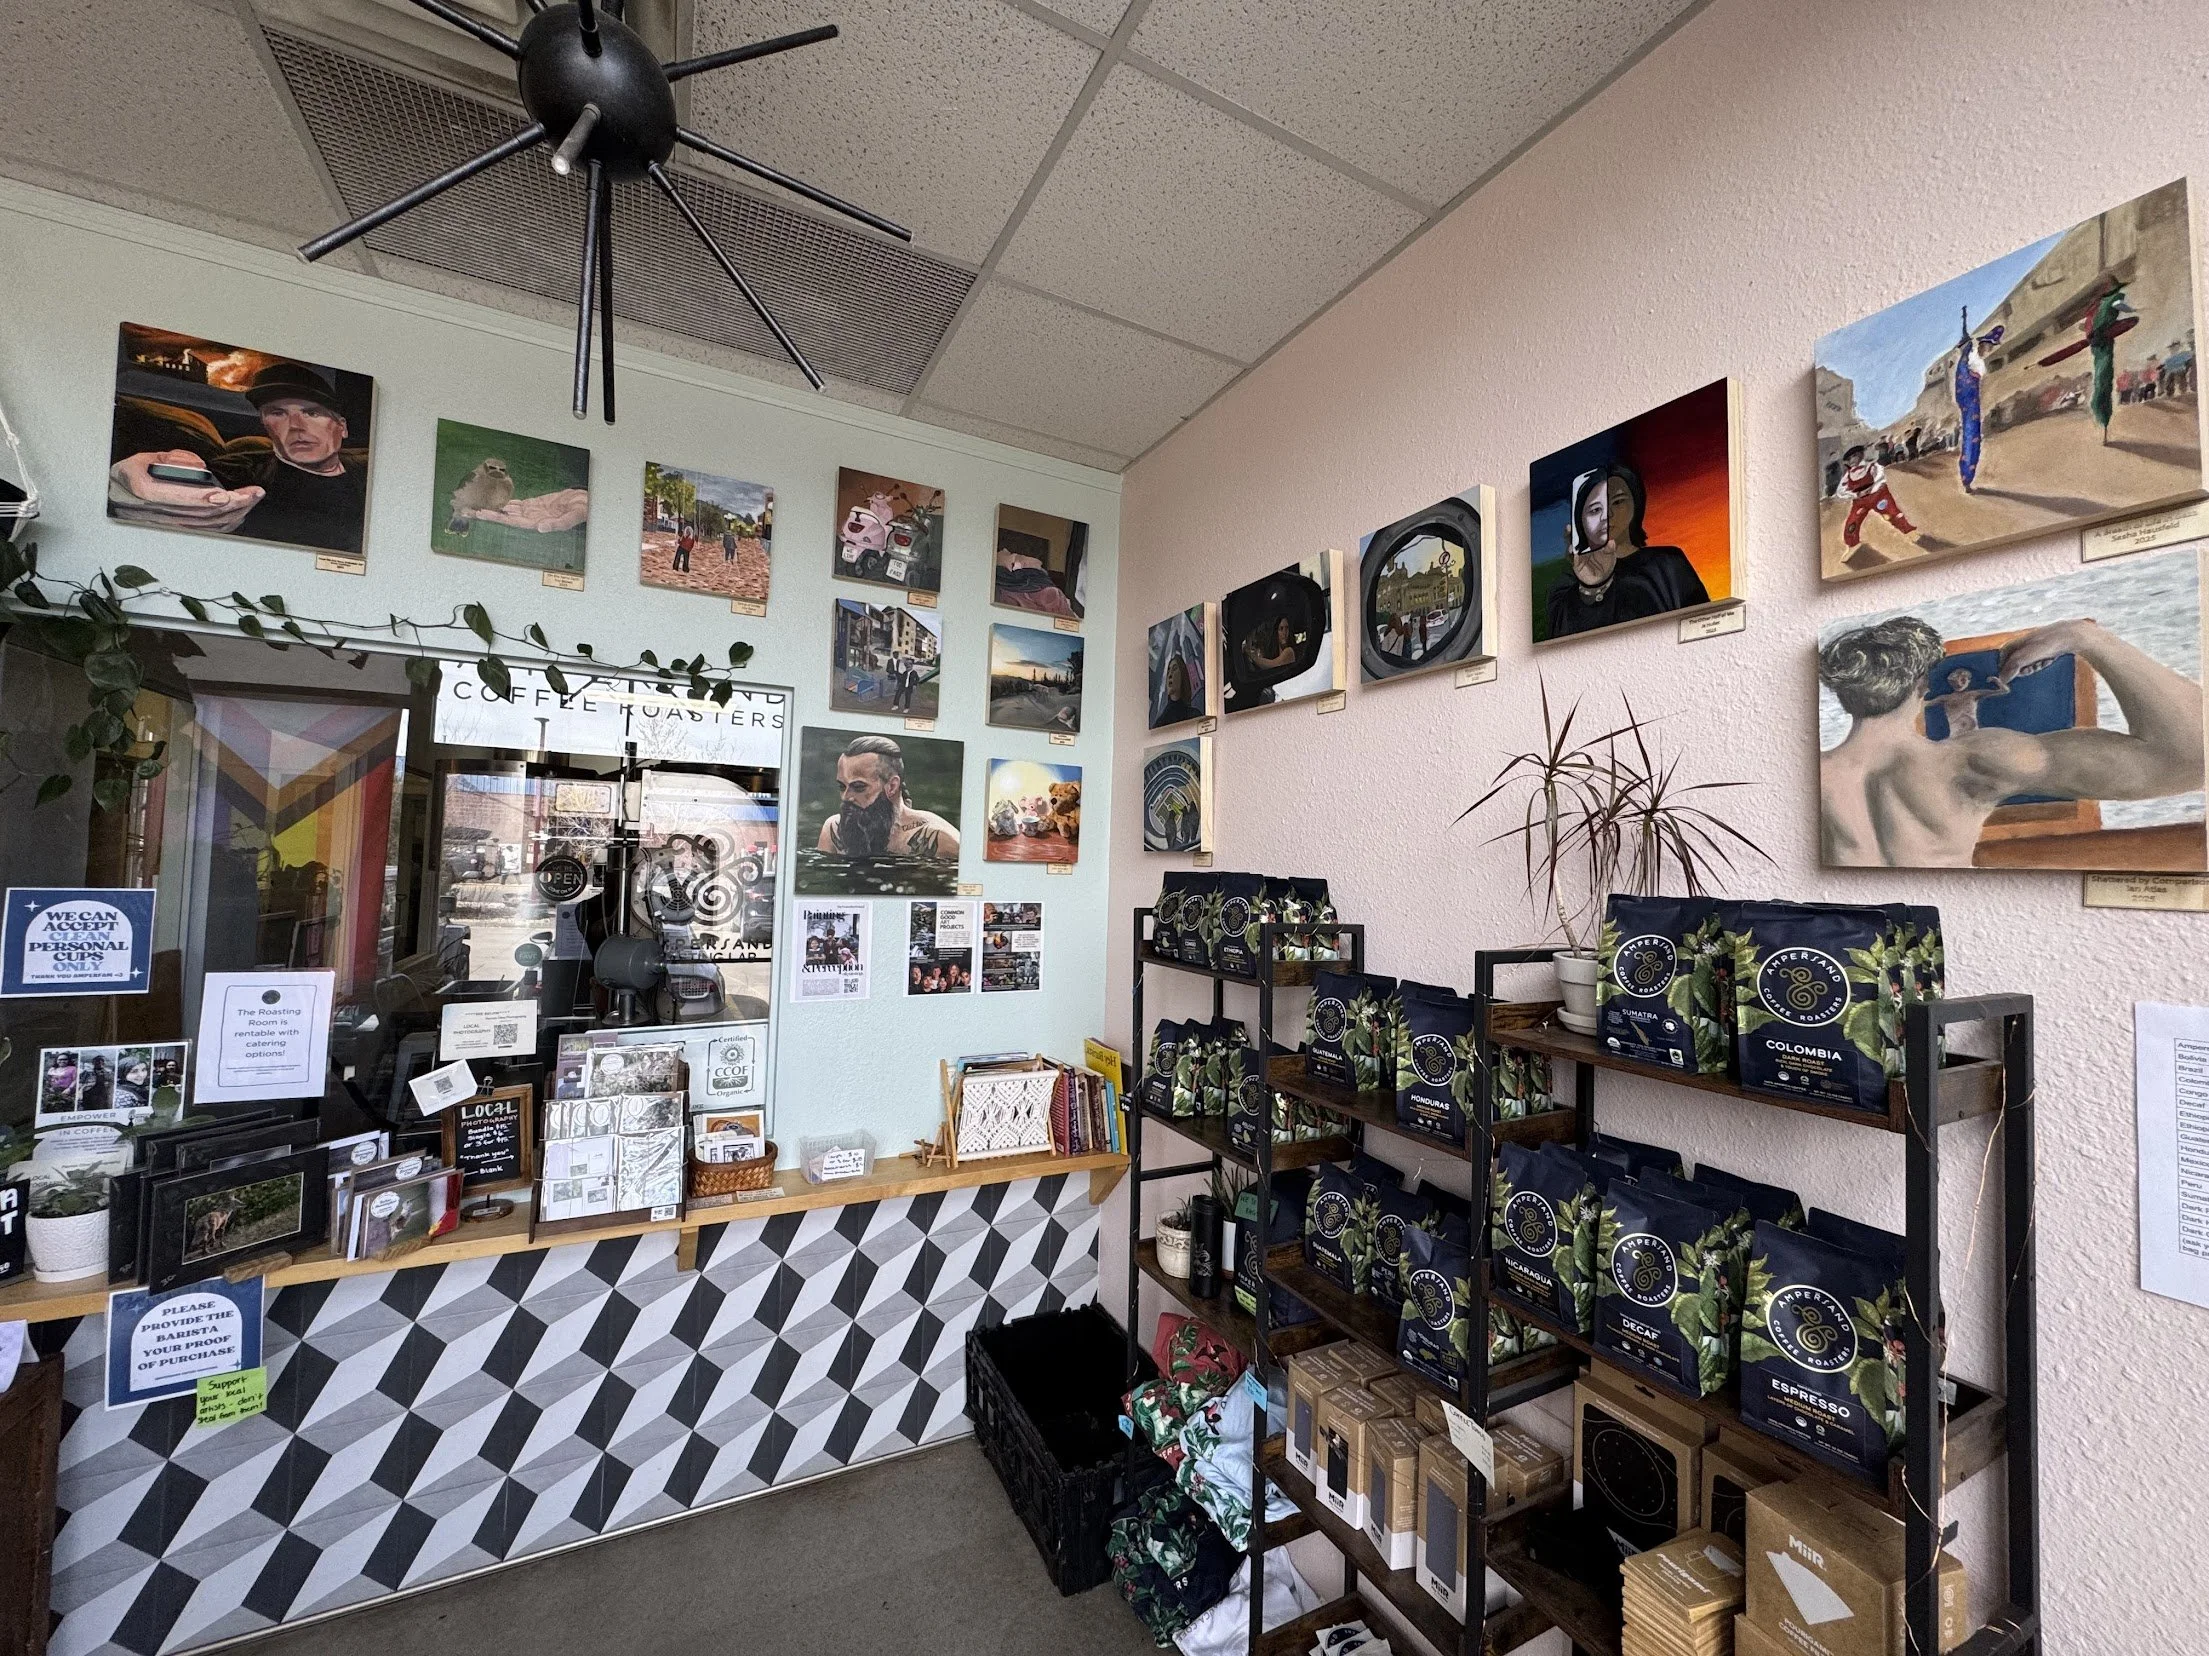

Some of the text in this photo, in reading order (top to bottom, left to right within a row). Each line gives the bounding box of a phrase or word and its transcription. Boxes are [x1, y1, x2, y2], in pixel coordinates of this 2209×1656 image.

[453, 681, 597, 712] COFFEE
[45, 911, 118, 921] WE CAN
[42, 921, 119, 931] ACCEPT
[48, 931, 111, 941] CLEAN
[28, 941, 129, 951] PERSONAL
[1623, 938, 1673, 961] AMPERSAND
[53, 951, 104, 961] CUPS
[52, 961, 103, 971] ONLY
[1766, 951, 1841, 983] AMPERSAND
[1619, 966, 1671, 993] COFFEE ROASTERS
[258, 1008, 302, 1016] Roasting
[1763, 987, 1842, 1021] COFFEE ROASTERS
[1621, 1008, 1658, 1021] SUMATRA
[245, 1040, 287, 1048] catering
[718, 1035, 748, 1043] Certified
[245, 1050, 286, 1059] options!
[1312, 1047, 1343, 1061] GUATEMALA
[1766, 1039, 1843, 1061] COLOMBIA
[2178, 1054, 2208, 1062] Bolivia
[1781, 1054, 1825, 1066] DARK ROAST
[714, 1066, 749, 1077] CCOF
[2178, 1065, 2204, 1073] Brazil
[716, 1088, 744, 1098] Organic
[2179, 1087, 2208, 1098] Congo
[461, 1101, 518, 1119] LOCAL
[1410, 1094, 1450, 1110] HONDURAS
[2179, 1099, 2206, 1108] Decaf
[60, 1112, 117, 1122] EMPOWER
[461, 1114, 519, 1128] PHOTOGRAPHY
[59, 1127, 72, 1136] IN
[467, 1132, 491, 1141] Single
[468, 1126, 494, 1135] Bundle
[479, 1165, 503, 1174] Blank
[2181, 1179, 2203, 1189] Peru
[1512, 1194, 1553, 1227] AMPERSAND
[2182, 1202, 2203, 1213] Dark
[2182, 1214, 2203, 1224] Dark
[1508, 1218, 1553, 1253] COFFEE ROASTERS
[2182, 1225, 2203, 1236] Dark
[1621, 1238, 1672, 1272] AMPERSAND
[1505, 1257, 1552, 1287] NICARAGUA
[1413, 1273, 1451, 1302] AMPERSAND
[1616, 1262, 1671, 1302] COFFEE ROASTERS
[162, 1300, 217, 1317] PLEASE
[1777, 1291, 1849, 1332] AMPERSAND
[141, 1310, 235, 1333] PROVIDE THE
[1622, 1318, 1658, 1340] DECAF
[156, 1325, 219, 1343] BARISTA
[143, 1334, 232, 1358] YOUR PROOF
[1773, 1319, 1850, 1366] COFFEE ROASTERS
[137, 1345, 236, 1371] OF PURCHASE
[208, 1375, 249, 1391] Support
[200, 1386, 246, 1406] your local
[200, 1402, 226, 1414] artists
[237, 1393, 264, 1406] don't
[1771, 1378, 1850, 1418] ESPRESSO
[1783, 1396, 1836, 1421] MEDIUM ROAST
[197, 1414, 216, 1424] steal
[219, 1411, 236, 1419] from
[1328, 1492, 1345, 1510] MiiR
[1788, 1534, 1825, 1568] MiiR
[1431, 1576, 1449, 1600] MiiR
[1779, 1621, 1809, 1649] COFFEE
